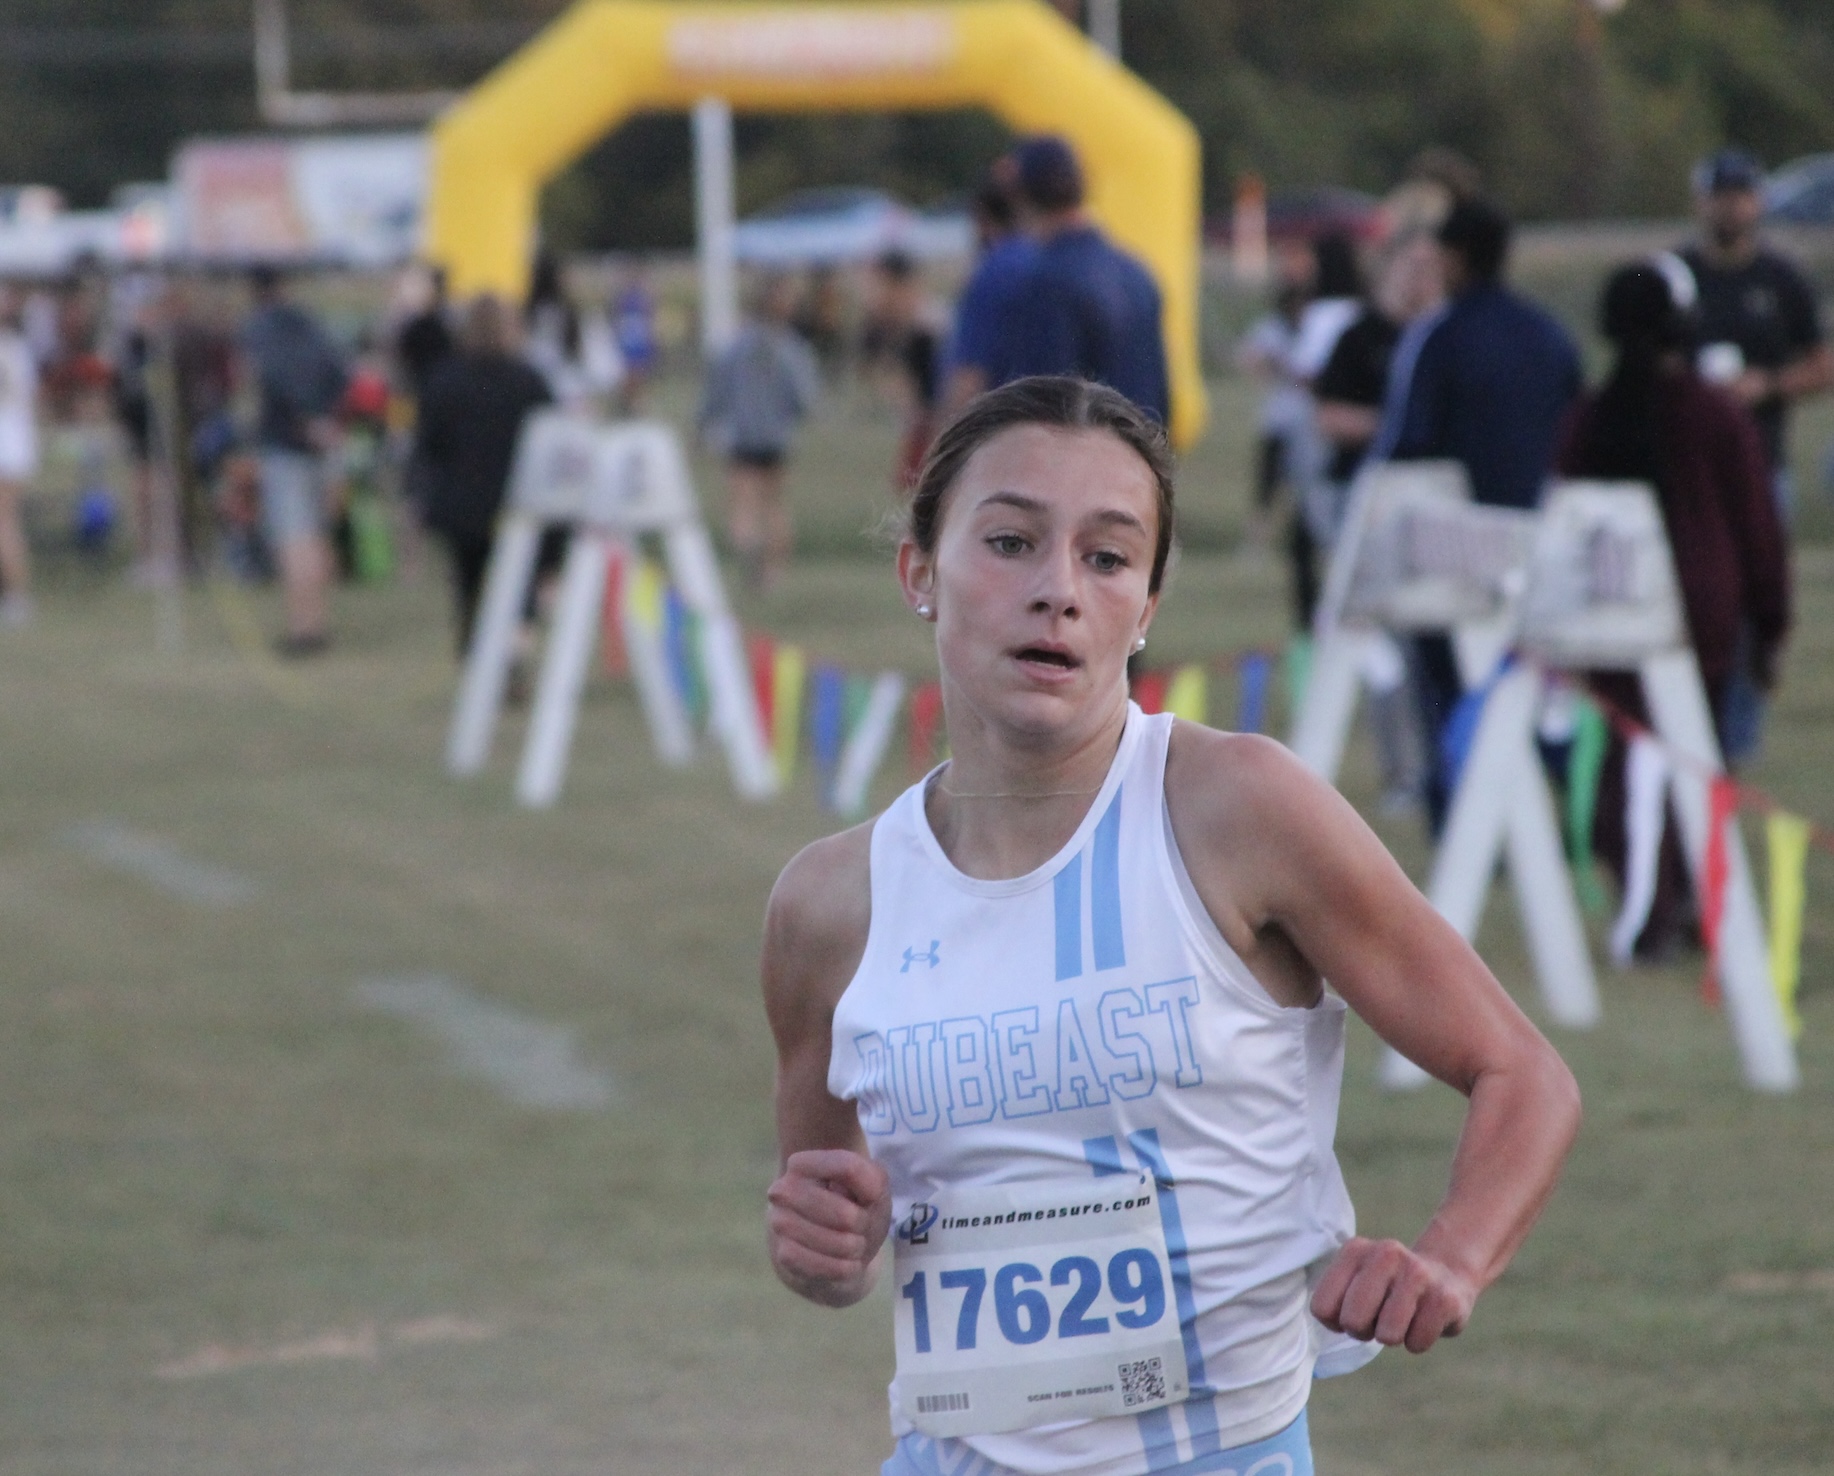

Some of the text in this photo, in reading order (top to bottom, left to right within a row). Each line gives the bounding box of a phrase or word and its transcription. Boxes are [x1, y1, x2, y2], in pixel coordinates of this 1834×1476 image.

[853, 975, 1203, 1136] DUBEAST
[941, 1195, 1151, 1230] timeandmeasure.com
[902, 1247, 1166, 1354] 17629
[1027, 1384, 1114, 1403] SCAN FOR RESULTS
